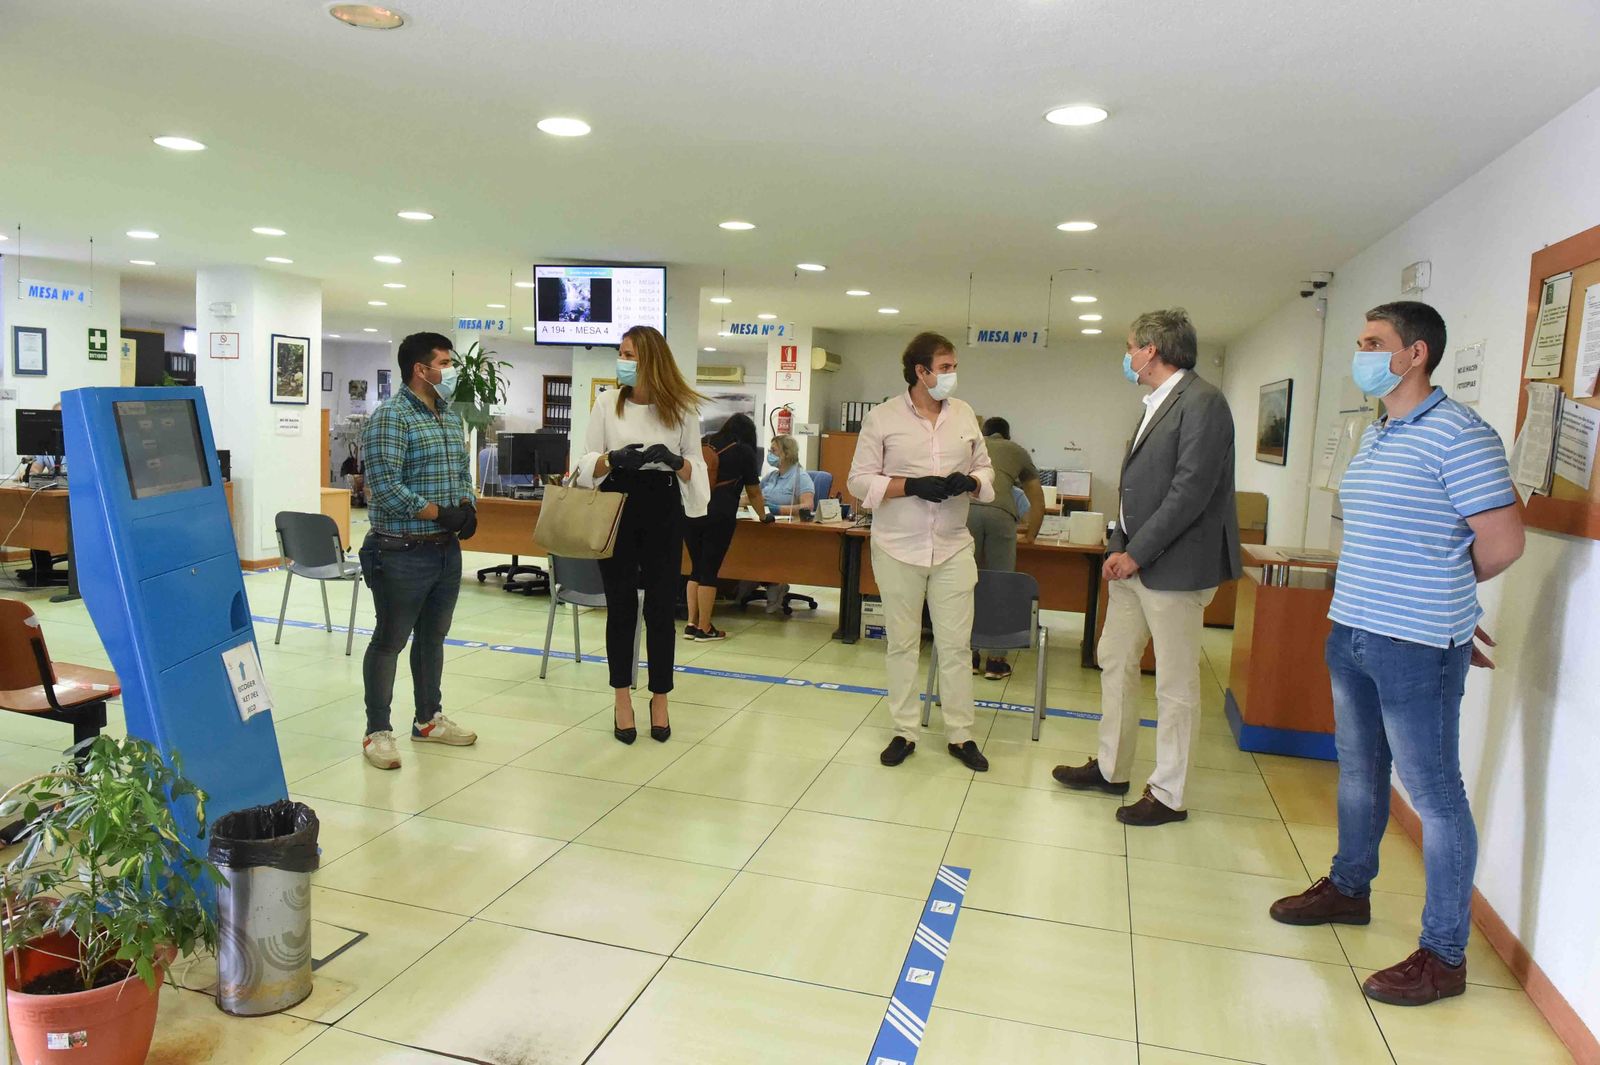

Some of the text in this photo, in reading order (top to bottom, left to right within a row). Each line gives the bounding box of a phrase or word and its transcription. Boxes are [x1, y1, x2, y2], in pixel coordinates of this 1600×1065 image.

[28, 285, 58, 300] MESA
[78, 292, 84, 302] 4
[458, 320, 482, 330] MESA
[498, 320, 504, 330] 3
[576, 326, 602, 334] MESA
[730, 323, 758, 335] MESA
[778, 325, 785, 336] 2
[977, 330, 1009, 342] MESA
[1032, 332, 1038, 344] 1
